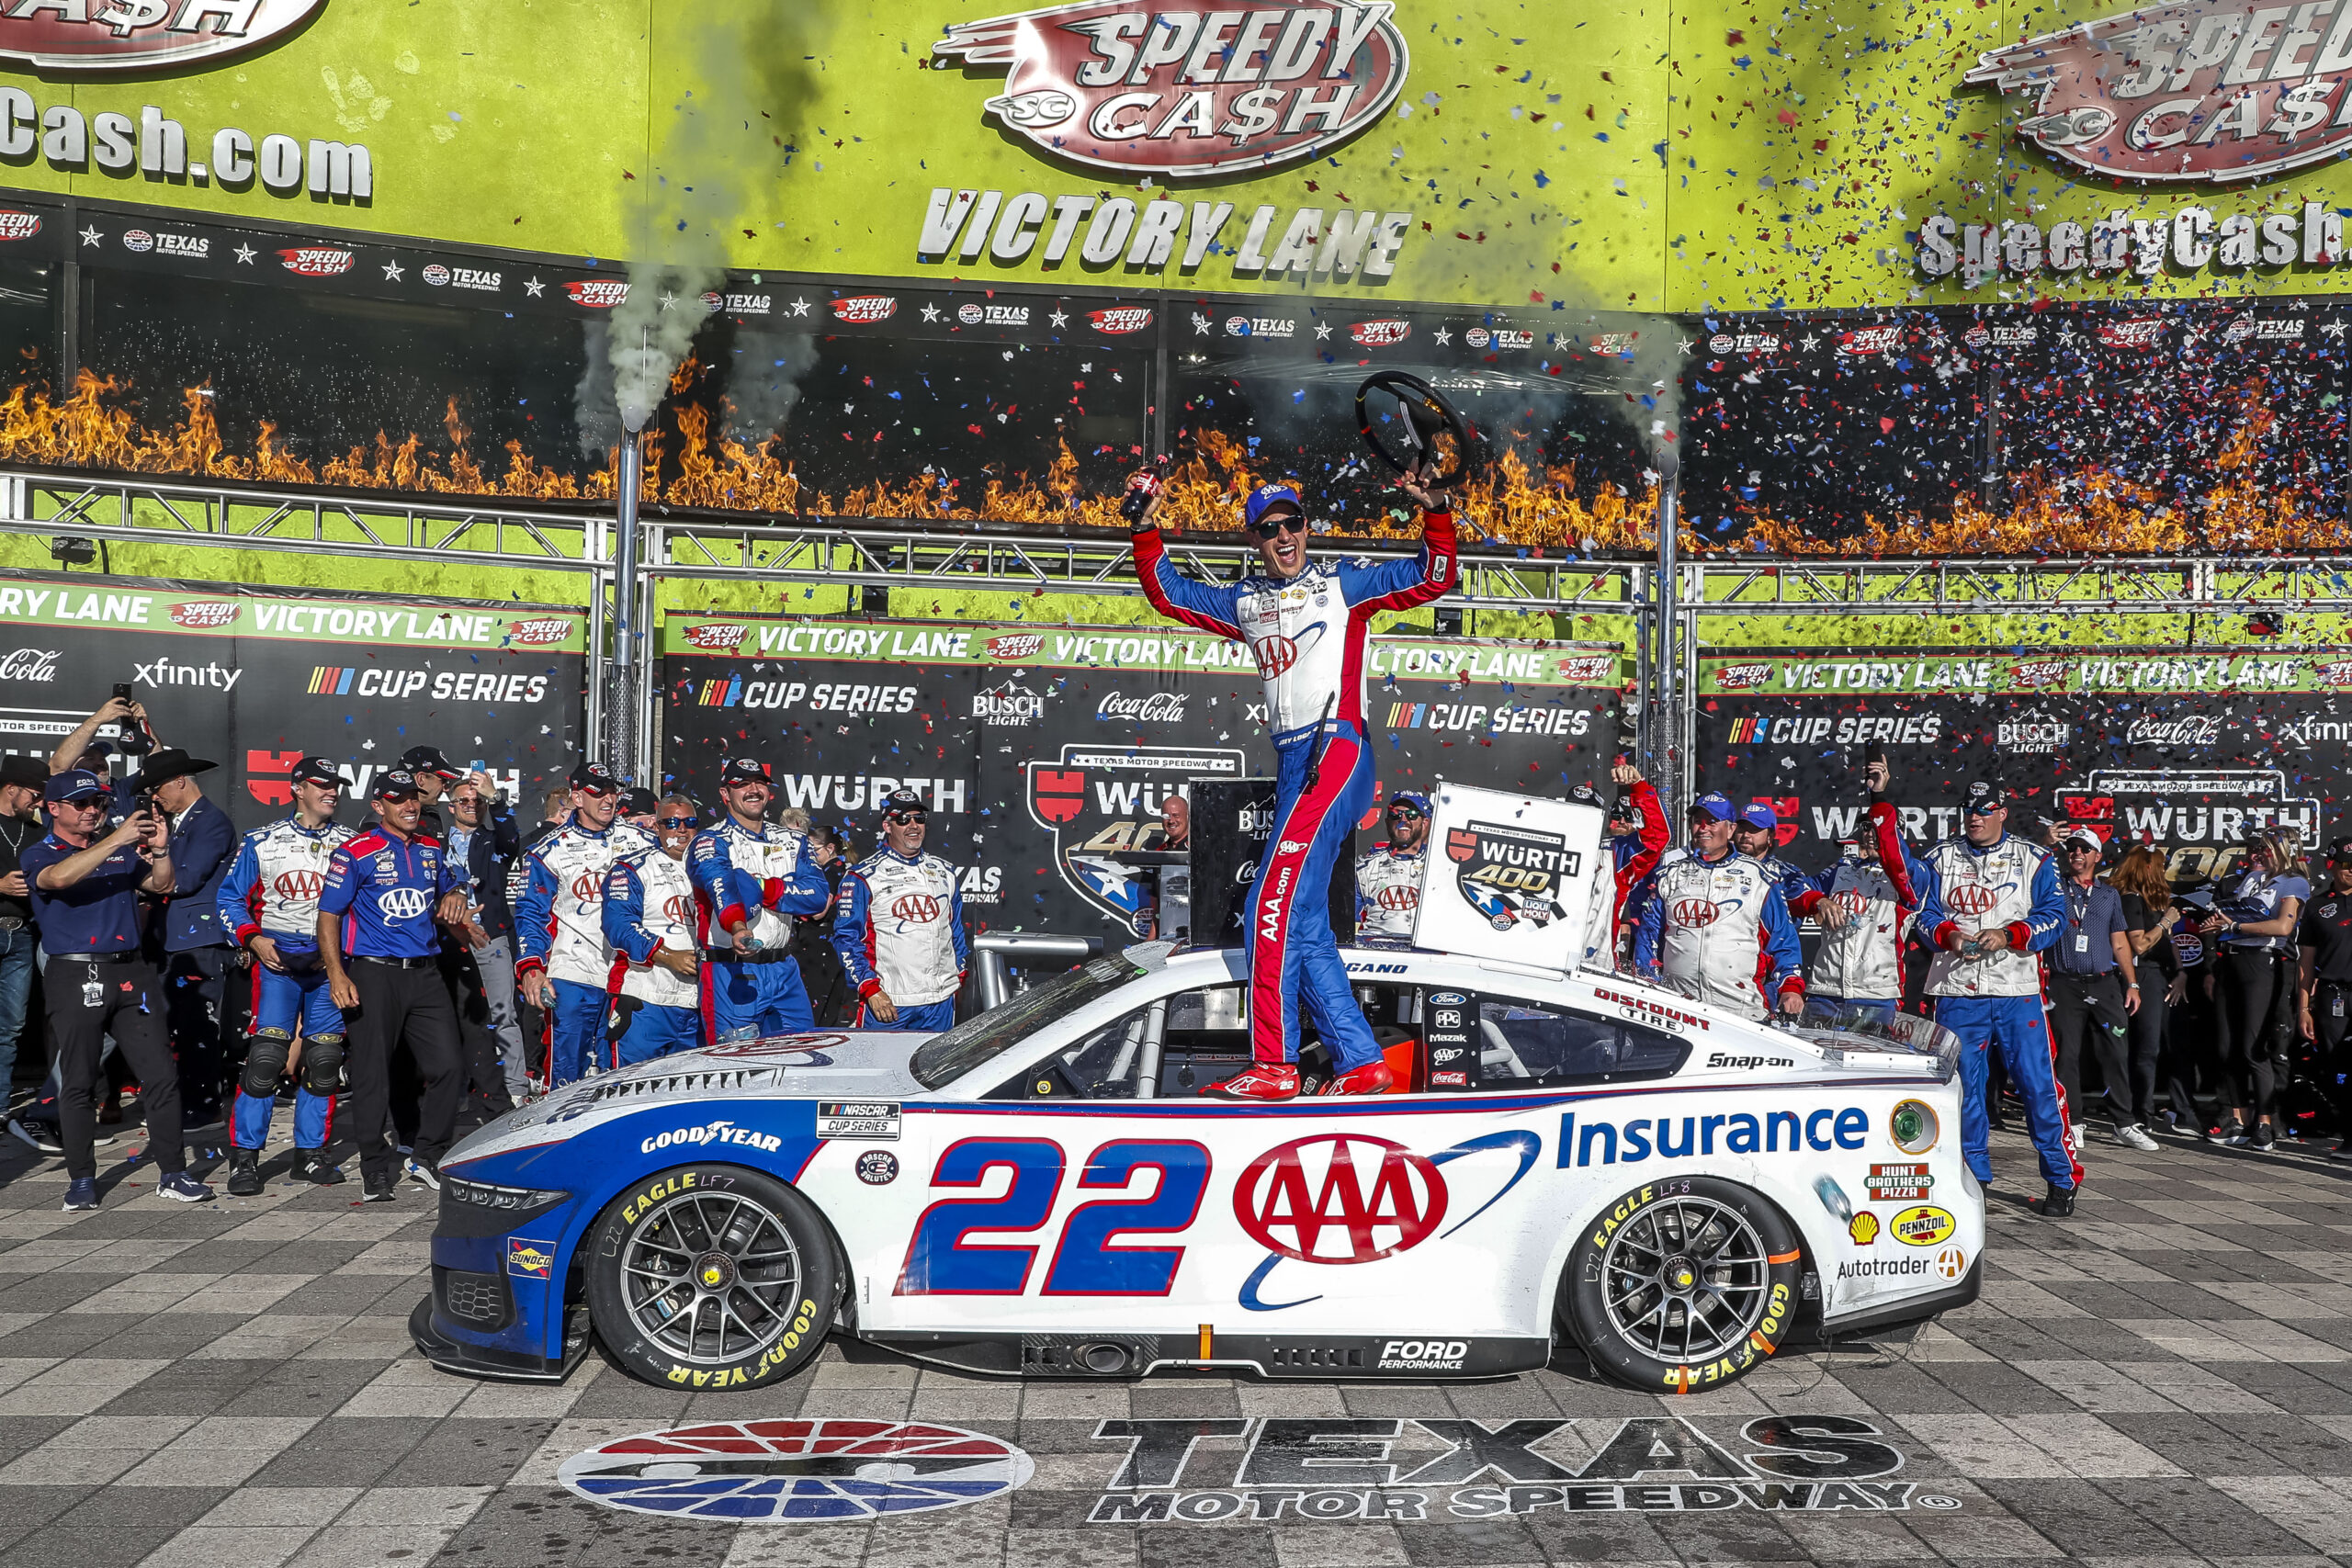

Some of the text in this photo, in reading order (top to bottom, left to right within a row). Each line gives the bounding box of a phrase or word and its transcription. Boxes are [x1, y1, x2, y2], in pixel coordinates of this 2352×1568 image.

[1062, 6, 1391, 86] SPEEDY
[1009, 94, 1069, 120] SC
[919, 187, 1412, 275] VICTORY LANE
[156, 232, 209, 252] TEXAS
[297, 250, 353, 265] SPEEDY
[453, 267, 502, 286] TEXAS
[582, 282, 632, 296] SPEEDY
[726, 294, 771, 309] TEXAS
[848, 298, 895, 311] SPEEDY
[985, 306, 1029, 320] TEXAS
[1103, 309, 1150, 322] SPEEDY
[1251, 318, 1295, 333] TEXAS
[1363, 321, 1409, 334] SPEEDY
[2256, 321, 2304, 334] TEXAS
[1736, 334, 1780, 348] TEXAS
[55, 591, 152, 623] LANE
[184, 603, 238, 616] SPEEDY
[254, 603, 492, 642] VICTORY LANE
[521, 620, 571, 634] SPEEDY
[699, 625, 748, 639] SPEEDY
[759, 626, 971, 658] VICTORY LANE
[997, 635, 1045, 649] SPEEDY
[1057, 636, 1257, 667] VICTORY LANE
[1255, 636, 1295, 680] AAA
[1370, 648, 1544, 678] CTORY LANE
[133, 657, 243, 693] xfinity
[1726, 664, 1771, 678] SPEEDY
[1783, 663, 1909, 688] VICTORY
[1914, 662, 1993, 687] LANE
[2080, 661, 2211, 687] VICTORY
[2221, 660, 2300, 686] LANE
[358, 669, 548, 703] CUP SERIES
[743, 682, 917, 713] CUP SERIES
[972, 696, 1044, 718] BUSCH
[1098, 691, 1190, 722] Coca-Cola
[1429, 704, 1590, 735] CUP SERIES
[2127, 715, 2223, 745] Coca-Cola
[2285, 715, 2352, 745] xfini
[1771, 717, 1941, 744] CUP SERIES
[1998, 724, 2069, 745] BUSCH
[1162, 760, 1211, 769] SPEEDWAY
[2125, 807, 2311, 842] WÜRTH
[1521, 833, 1549, 841] SPEEDWAY
[1482, 840, 1577, 874] WÜRTH
[279, 870, 322, 901] AAA
[1470, 864, 1551, 892] 400
[380, 888, 425, 919] AAA
[898, 895, 938, 923] AAA
[1261, 867, 1292, 942] AAA.com
[1525, 901, 1549, 911] LIQUI
[1951, 885, 1994, 914] AAA
[1523, 909, 1548, 919] MOLY
[1677, 899, 1716, 928] AAA
[1345, 963, 1408, 974] GANO
[1434, 993, 1461, 1004] Ford
[1594, 987, 1711, 1031] DISCOUNT
[1438, 1012, 1459, 1026] PPG
[1628, 1009, 1678, 1030] TIRE
[1430, 1033, 1467, 1043] Mazak
[1434, 1049, 1454, 1062] AAA
[1707, 1052, 1794, 1070] Snap-on
[1279, 1080, 1295, 1090] 22
[1432, 1073, 1465, 1084] Coca-Cola
[843, 1104, 888, 1117] NASCAR
[828, 1121, 888, 1132] CUP SERIES
[1556, 1107, 1869, 1169] Insurance
[862, 1153, 893, 1165] NASCAR
[860, 1170, 893, 1182] SALUTES
[1867, 1176, 1931, 1188] BROTHERS
[1882, 1166, 1917, 1177] HUNT
[622, 1172, 696, 1224] EAGLE
[1245, 1134, 1436, 1265] AAA
[1881, 1187, 1918, 1198] PIZZA
[892, 1136, 1213, 1297] 22
[1593, 1186, 1653, 1249] EAGLE
[509, 1251, 551, 1269] SUNOCO
[1838, 1256, 1930, 1280] Autotrader
[1381, 1340, 1468, 1359] FORD
[1378, 1359, 1463, 1370] PERFORMANCE
[1091, 1416, 1905, 1487] TEXAS
[1086, 1490, 1431, 1523] MOTOR
